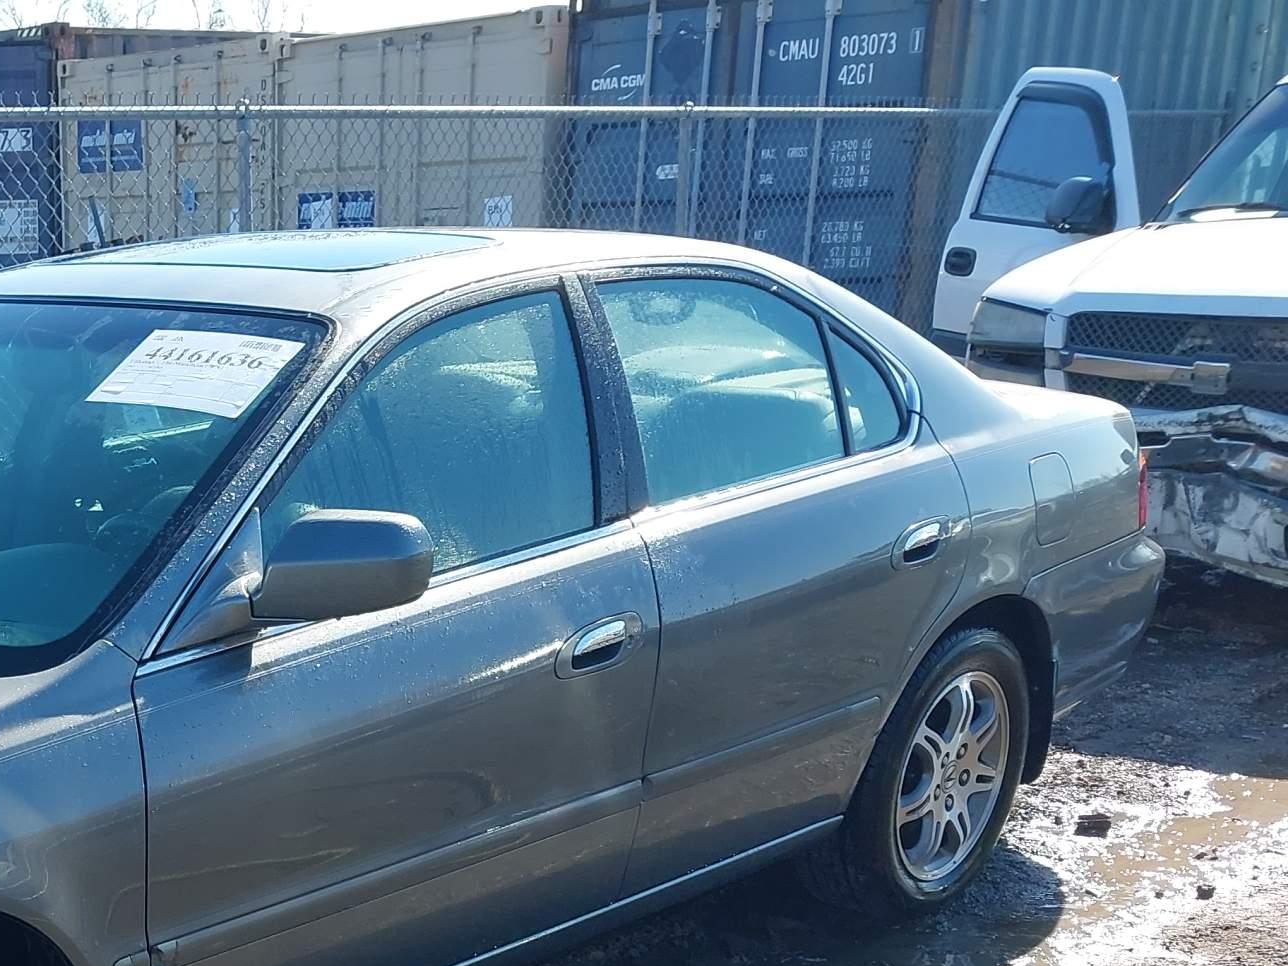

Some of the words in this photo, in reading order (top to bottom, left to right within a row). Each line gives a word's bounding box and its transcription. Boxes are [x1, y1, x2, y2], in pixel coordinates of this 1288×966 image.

[779, 38, 820, 61] CMAU
[839, 31, 898, 58] 803073
[591, 77, 619, 92] CMA
[837, 62, 875, 86] 42G1
[144, 346, 264, 370] 44161636
